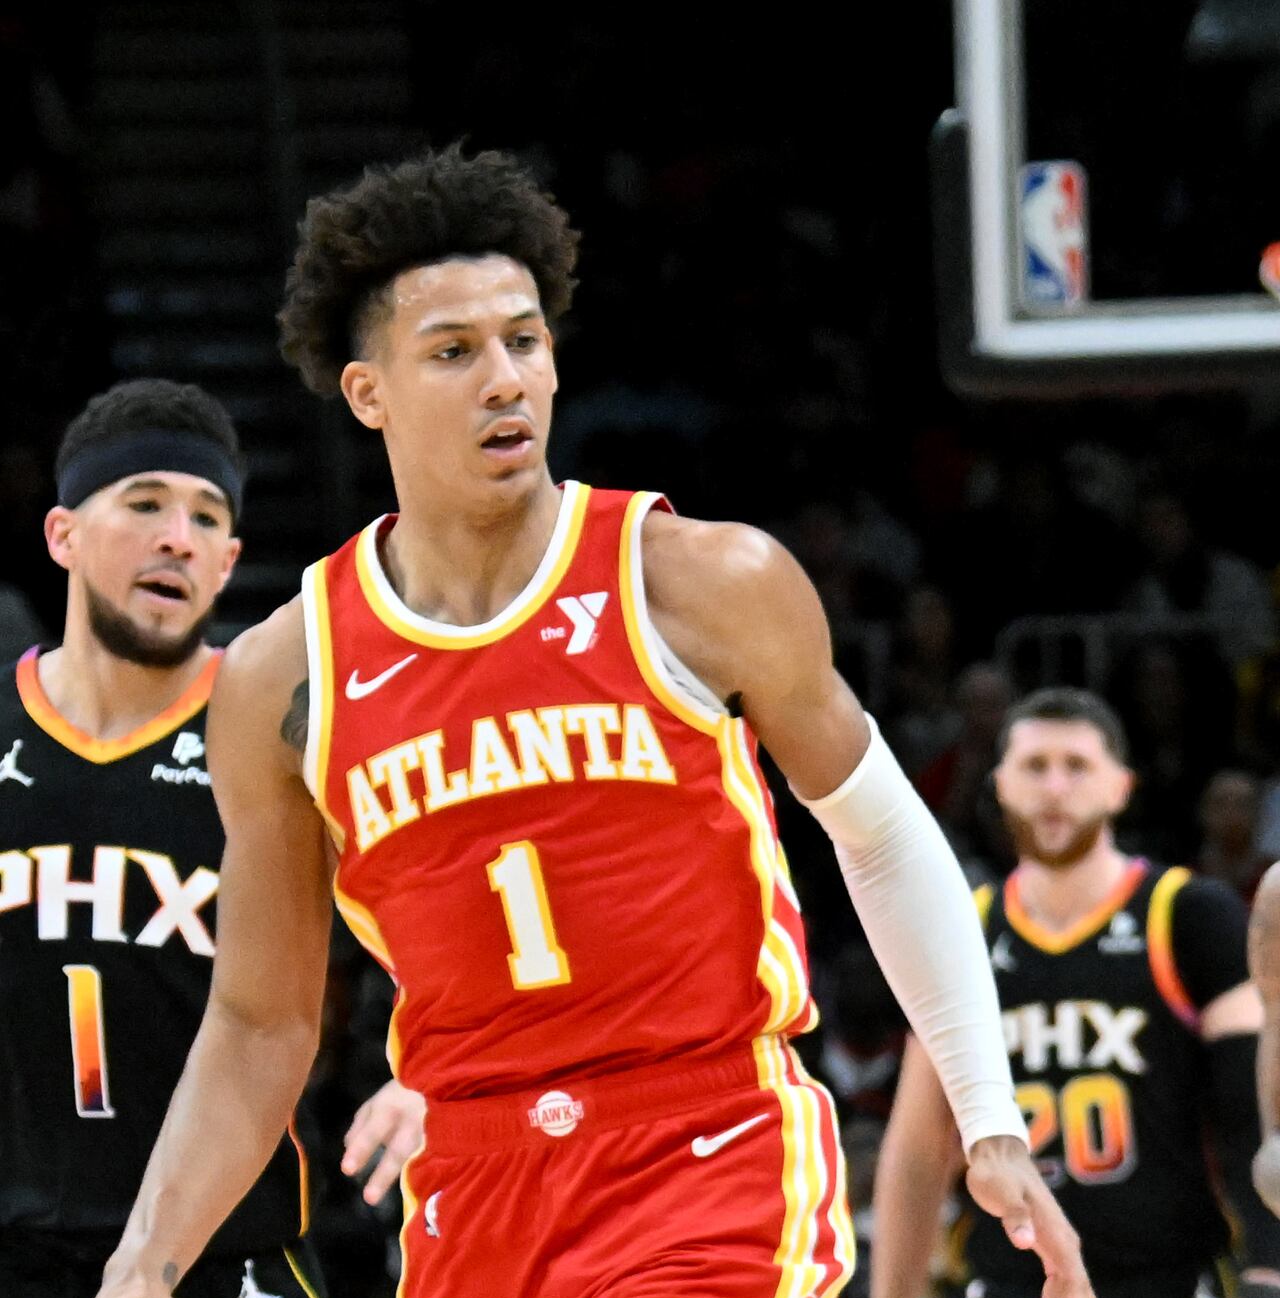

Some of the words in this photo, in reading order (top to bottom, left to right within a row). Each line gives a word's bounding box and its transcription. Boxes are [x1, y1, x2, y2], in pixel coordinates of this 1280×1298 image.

[150, 763, 212, 786] PayPa
[346, 704, 677, 855] ATLANTA
[486, 840, 571, 990] 1
[62, 964, 116, 1118] 1
[530, 1101, 584, 1125] HAWKS
[1014, 1073, 1136, 1185] 20
